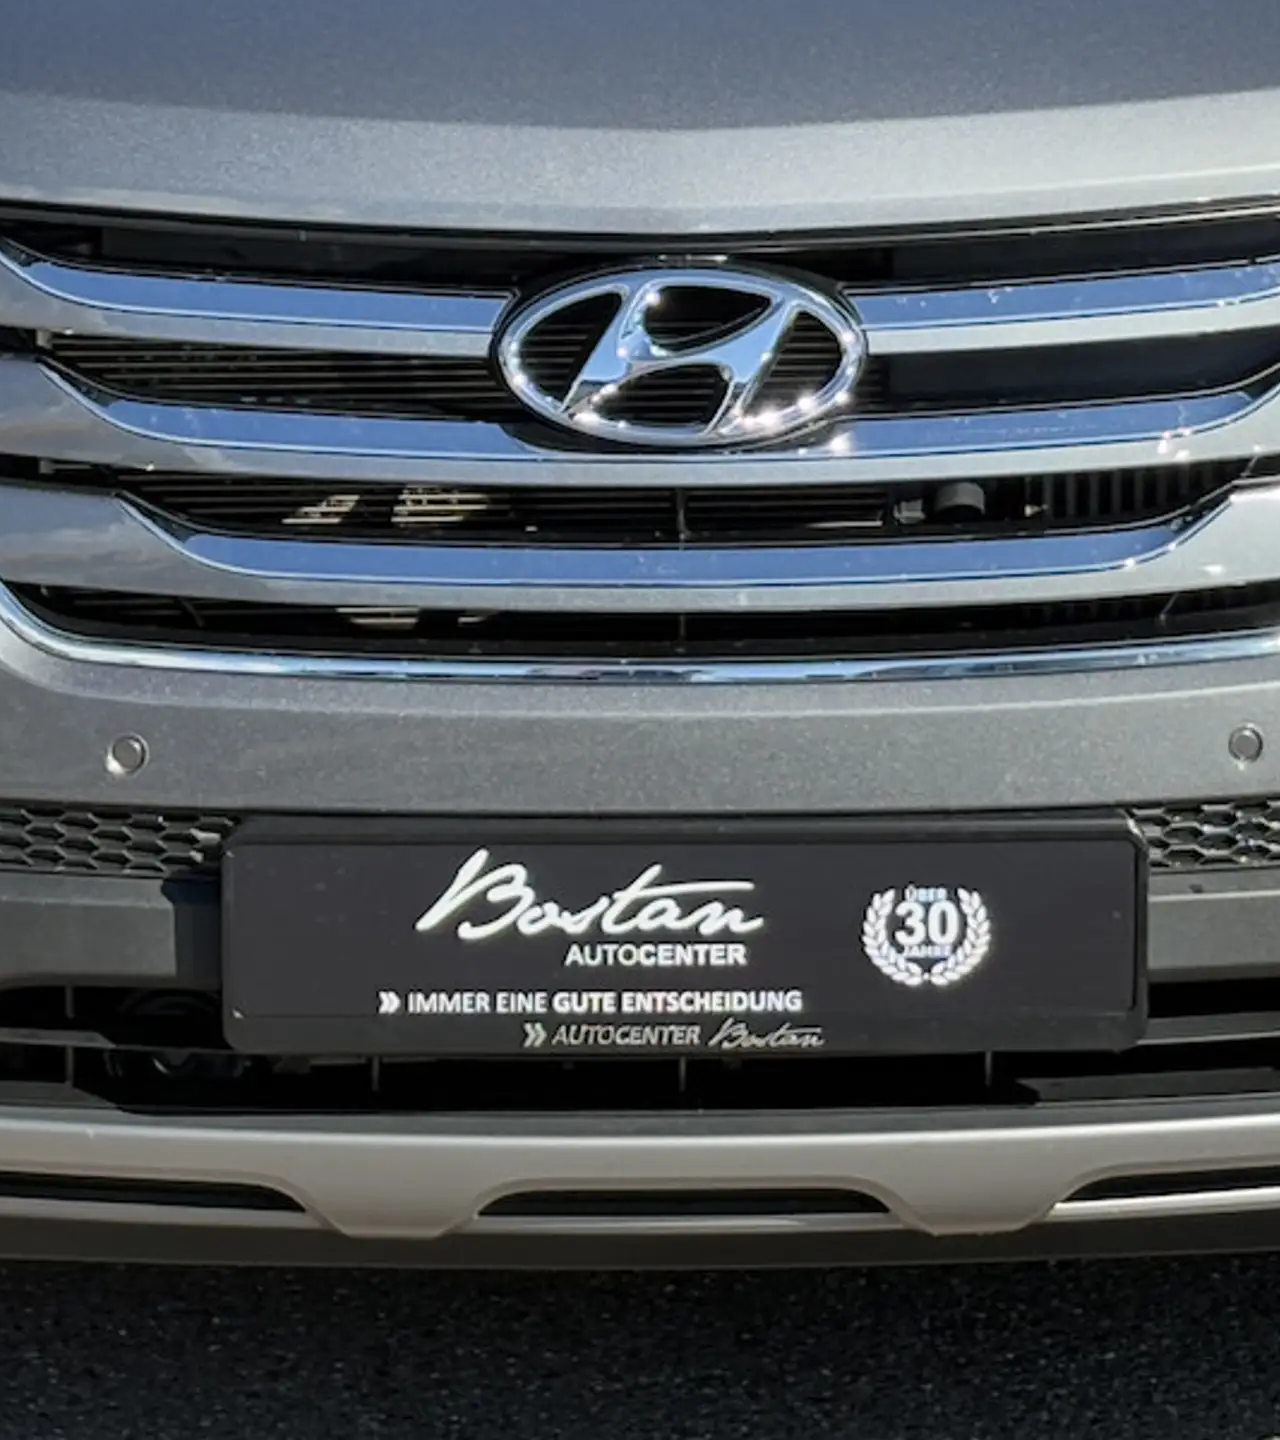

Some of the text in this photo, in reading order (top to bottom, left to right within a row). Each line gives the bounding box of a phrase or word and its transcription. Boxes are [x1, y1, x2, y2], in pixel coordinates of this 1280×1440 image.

[415, 848, 765, 940] Bostan
[894, 900, 959, 945] 30
[564, 943, 747, 967] AUTOCENTER
[408, 990, 803, 1013] IMMER EINE GUTE ENTSCHEIDUNG
[551, 1017, 826, 1050] AUTOCENTER Bostan
